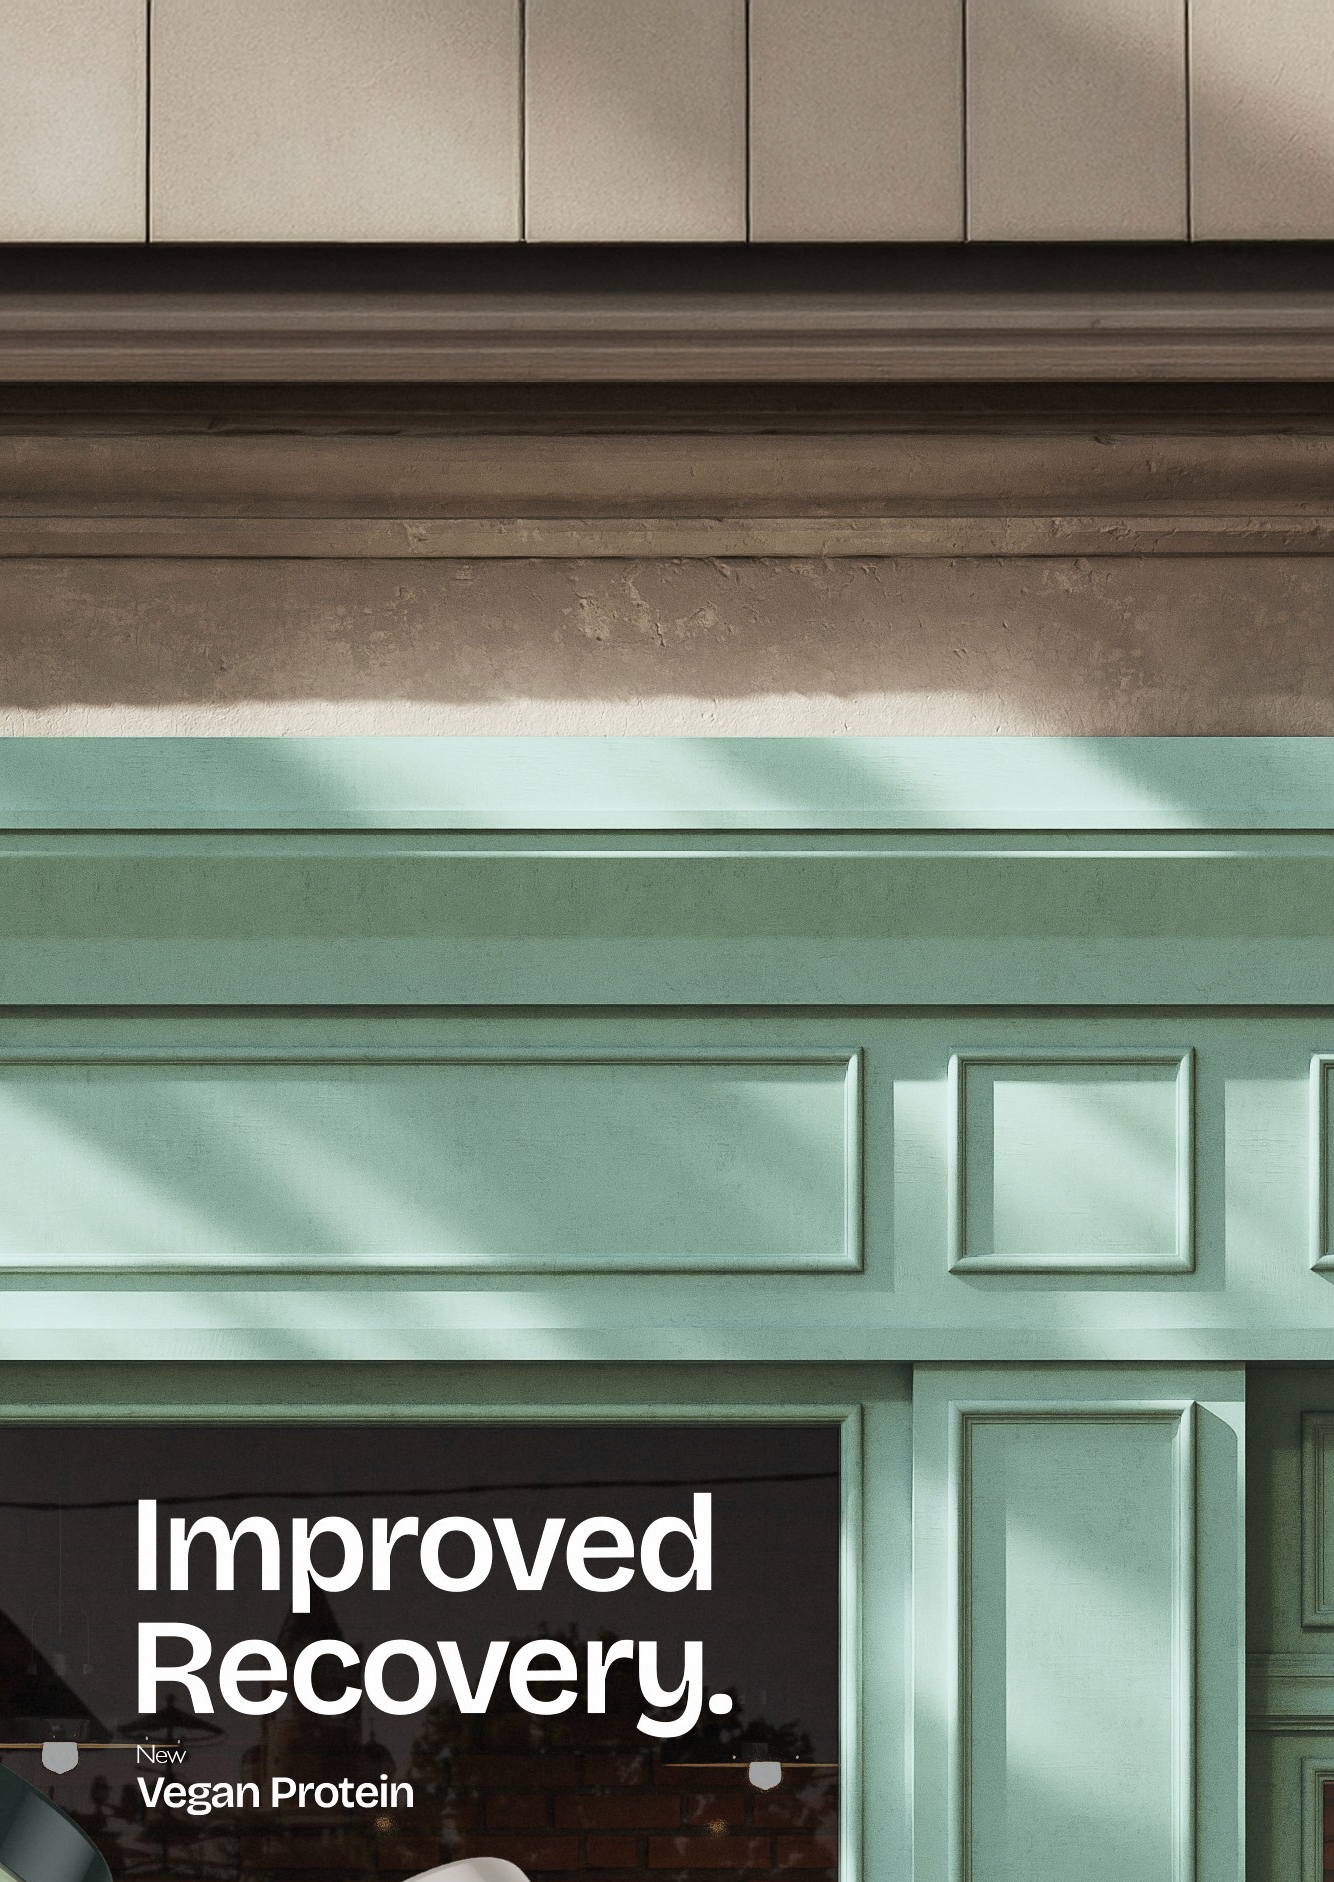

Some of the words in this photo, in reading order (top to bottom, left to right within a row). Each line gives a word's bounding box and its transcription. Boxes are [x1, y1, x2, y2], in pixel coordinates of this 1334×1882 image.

[138, 1492, 712, 1614] Improved
[138, 1622, 734, 1738] Recovery.
[136, 1744, 187, 1764] New
[137, 1776, 260, 1816] Vegan
[271, 1774, 414, 1809] Protein
